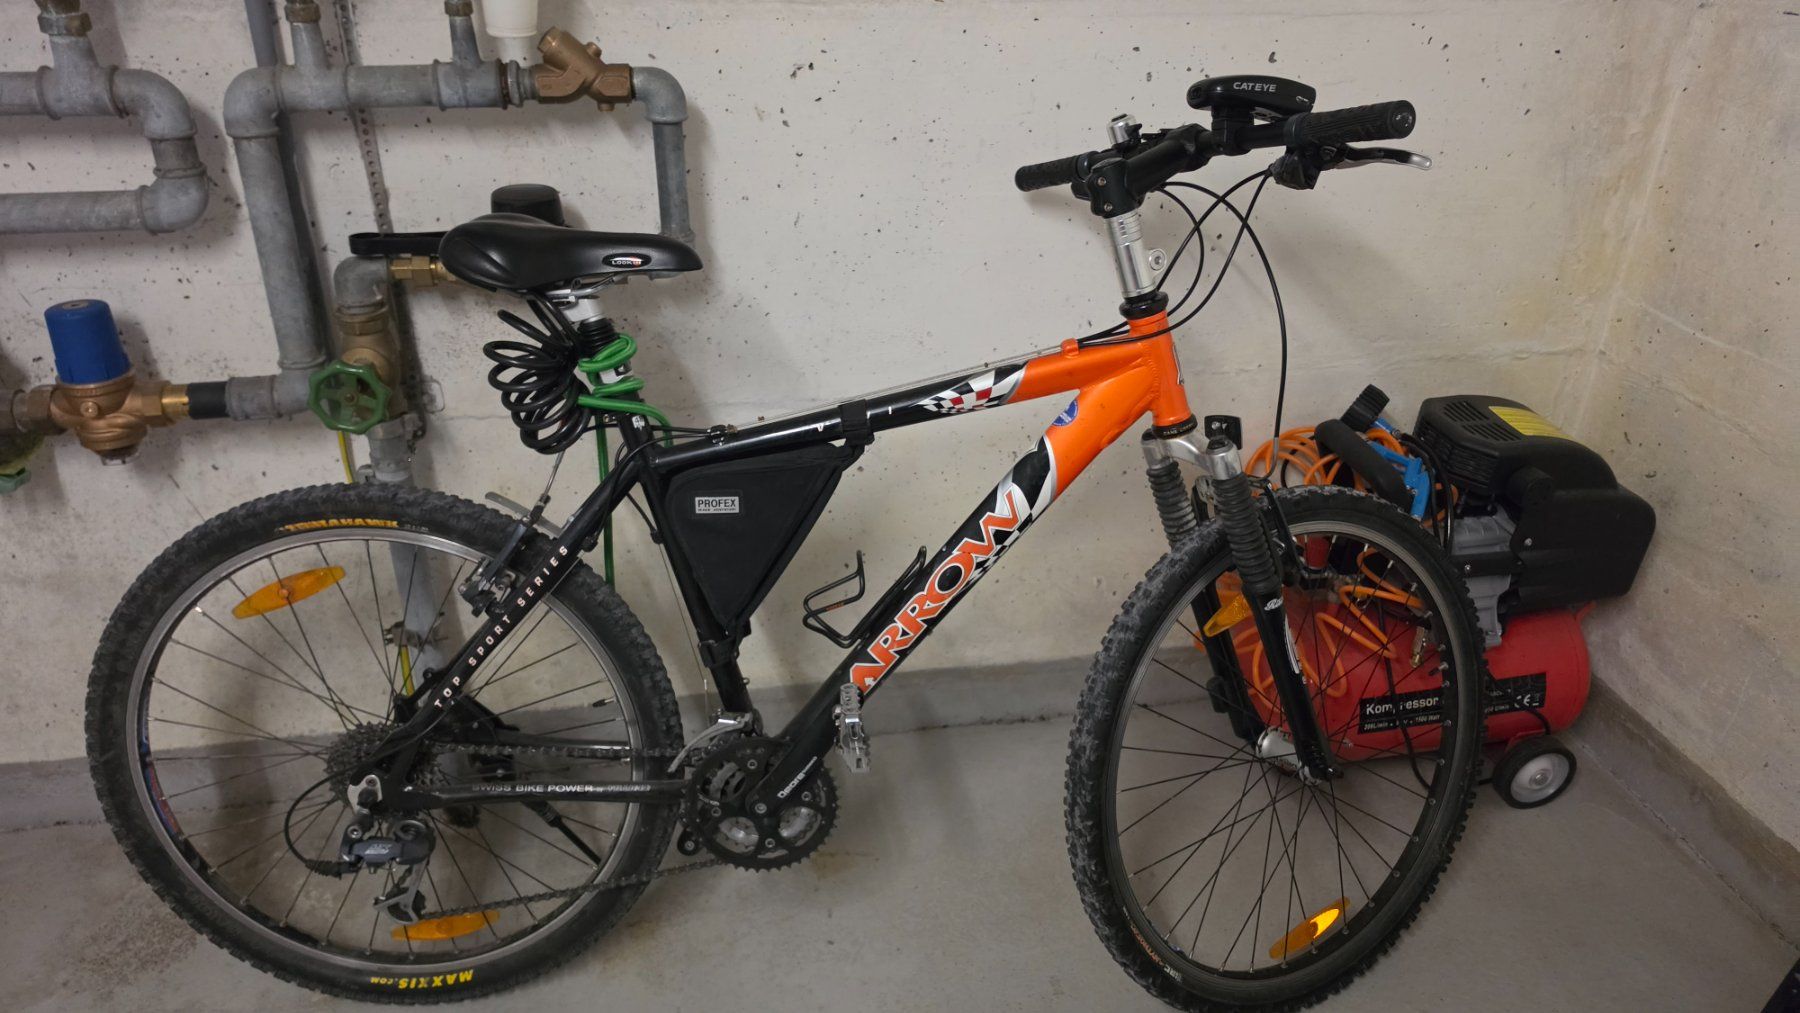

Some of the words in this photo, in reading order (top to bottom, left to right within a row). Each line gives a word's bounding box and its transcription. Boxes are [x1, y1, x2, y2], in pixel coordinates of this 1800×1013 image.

[1233, 81, 1277, 92] CATEYE
[697, 498, 736, 508] PROFEX
[850, 486, 1021, 695] ARROW
[434, 676, 461, 708] TOP
[468, 614, 511, 667] SPORT
[516, 545, 568, 607] SERIES
[472, 784, 512, 792] SWISS
[515, 784, 544, 793] BIKE
[547, 784, 593, 793] POWER
